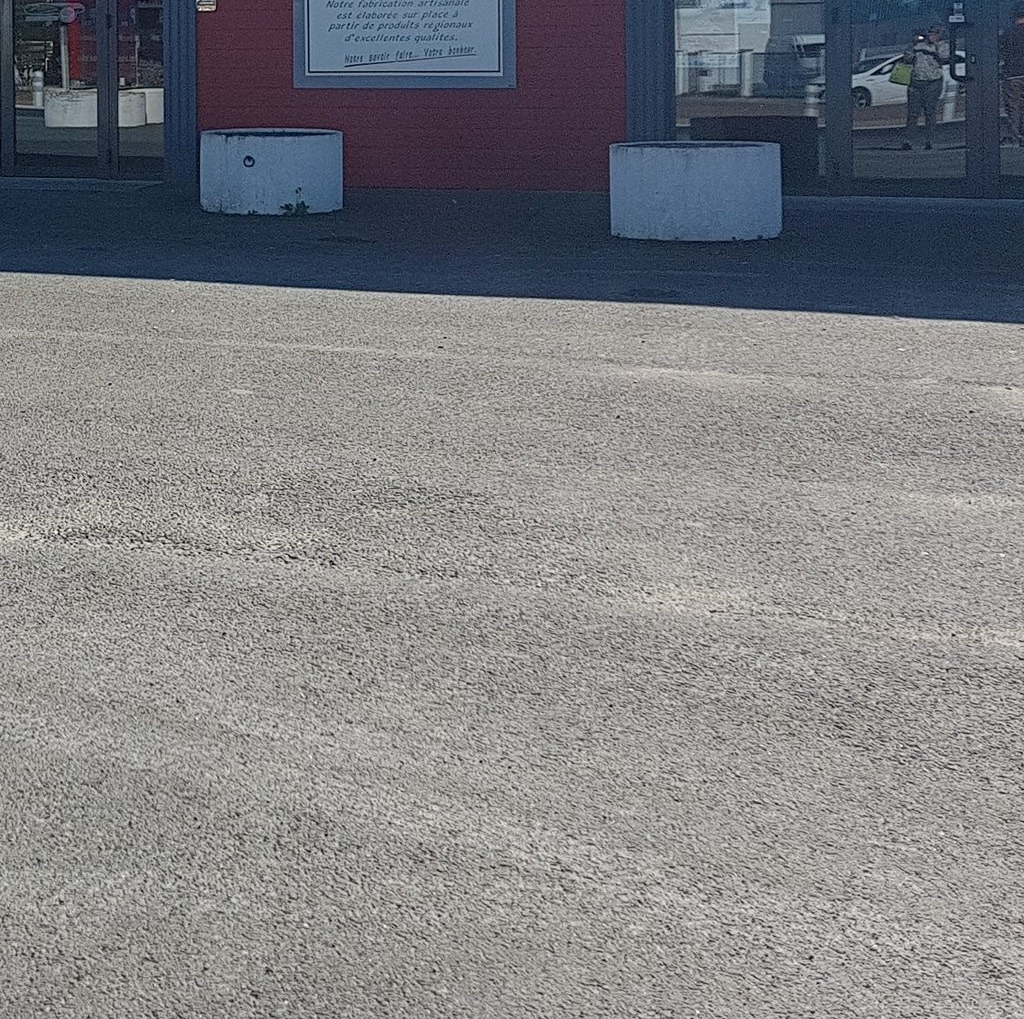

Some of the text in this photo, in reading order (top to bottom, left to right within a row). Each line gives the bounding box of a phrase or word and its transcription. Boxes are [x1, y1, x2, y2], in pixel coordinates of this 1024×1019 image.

[326, 0, 354, 9] Notre
[337, 11, 353, 20] est
[402, 11, 419, 19] sur
[420, 10, 449, 21] place
[328, 20, 360, 33] partir
[362, 21, 375, 30] de
[376, 19, 420, 32] produits
